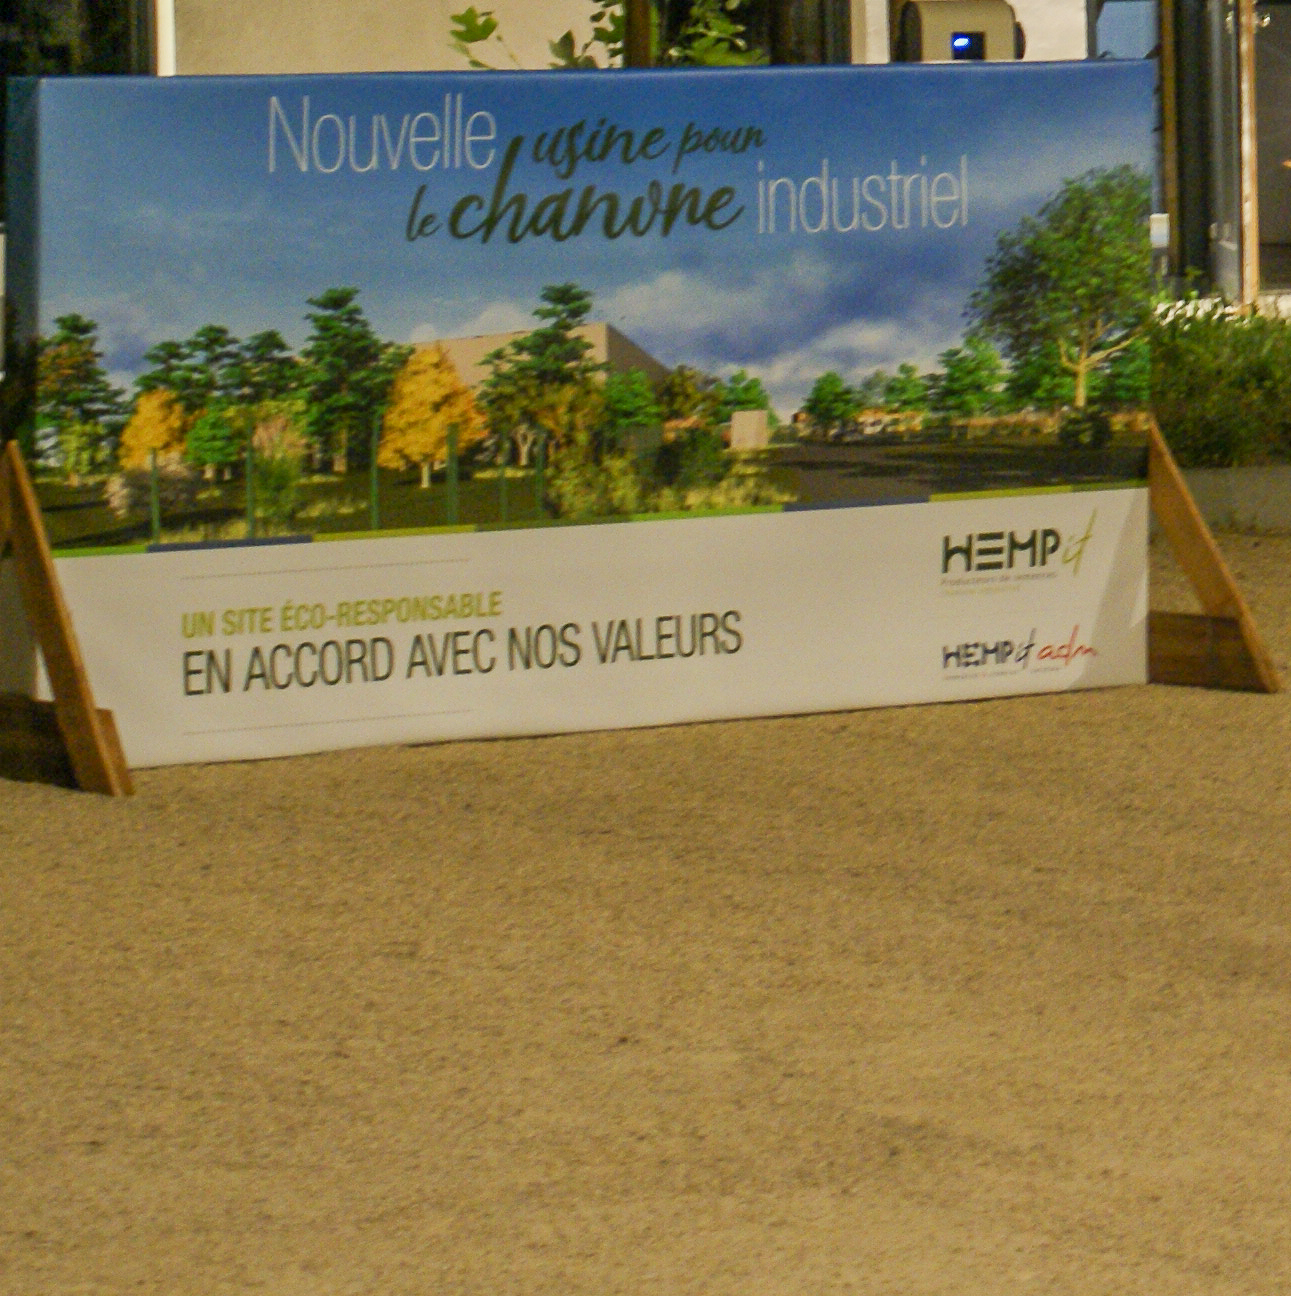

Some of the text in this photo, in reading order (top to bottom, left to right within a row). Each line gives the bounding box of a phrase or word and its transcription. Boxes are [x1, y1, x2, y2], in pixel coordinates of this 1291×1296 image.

[268, 92, 768, 180] Nouvelle usine pour
[405, 134, 969, 244] le chanvre industriel
[181, 591, 504, 639] UN SITE ÉCO-RESPONSABLE
[183, 609, 744, 696] EN ACCORD AVEC NOS VALEURS
